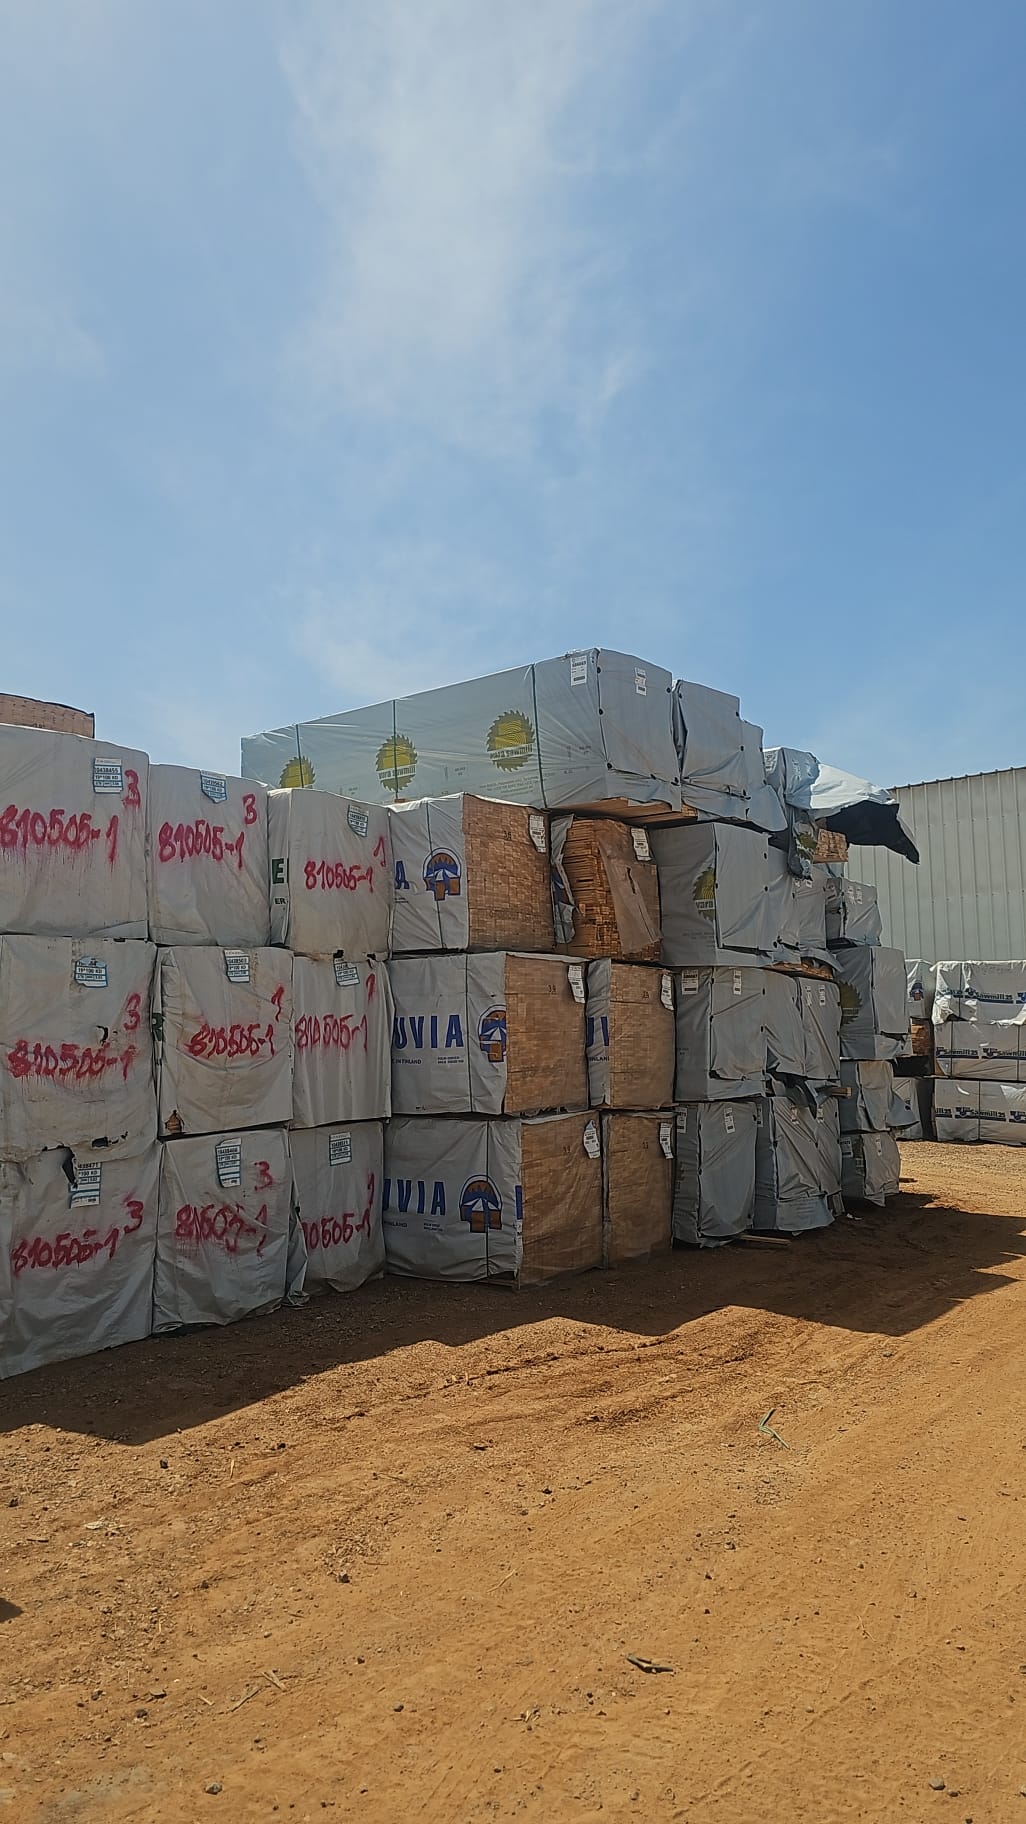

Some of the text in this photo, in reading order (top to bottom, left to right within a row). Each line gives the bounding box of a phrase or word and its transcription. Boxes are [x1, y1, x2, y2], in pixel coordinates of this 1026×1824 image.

[243, 794, 257, 824] 3
[159, 820, 245, 870] 810505-1
[304, 860, 374, 893] 810505-1
[253, 1161, 273, 1192] 3
[124, 1200, 144, 1234] 3
